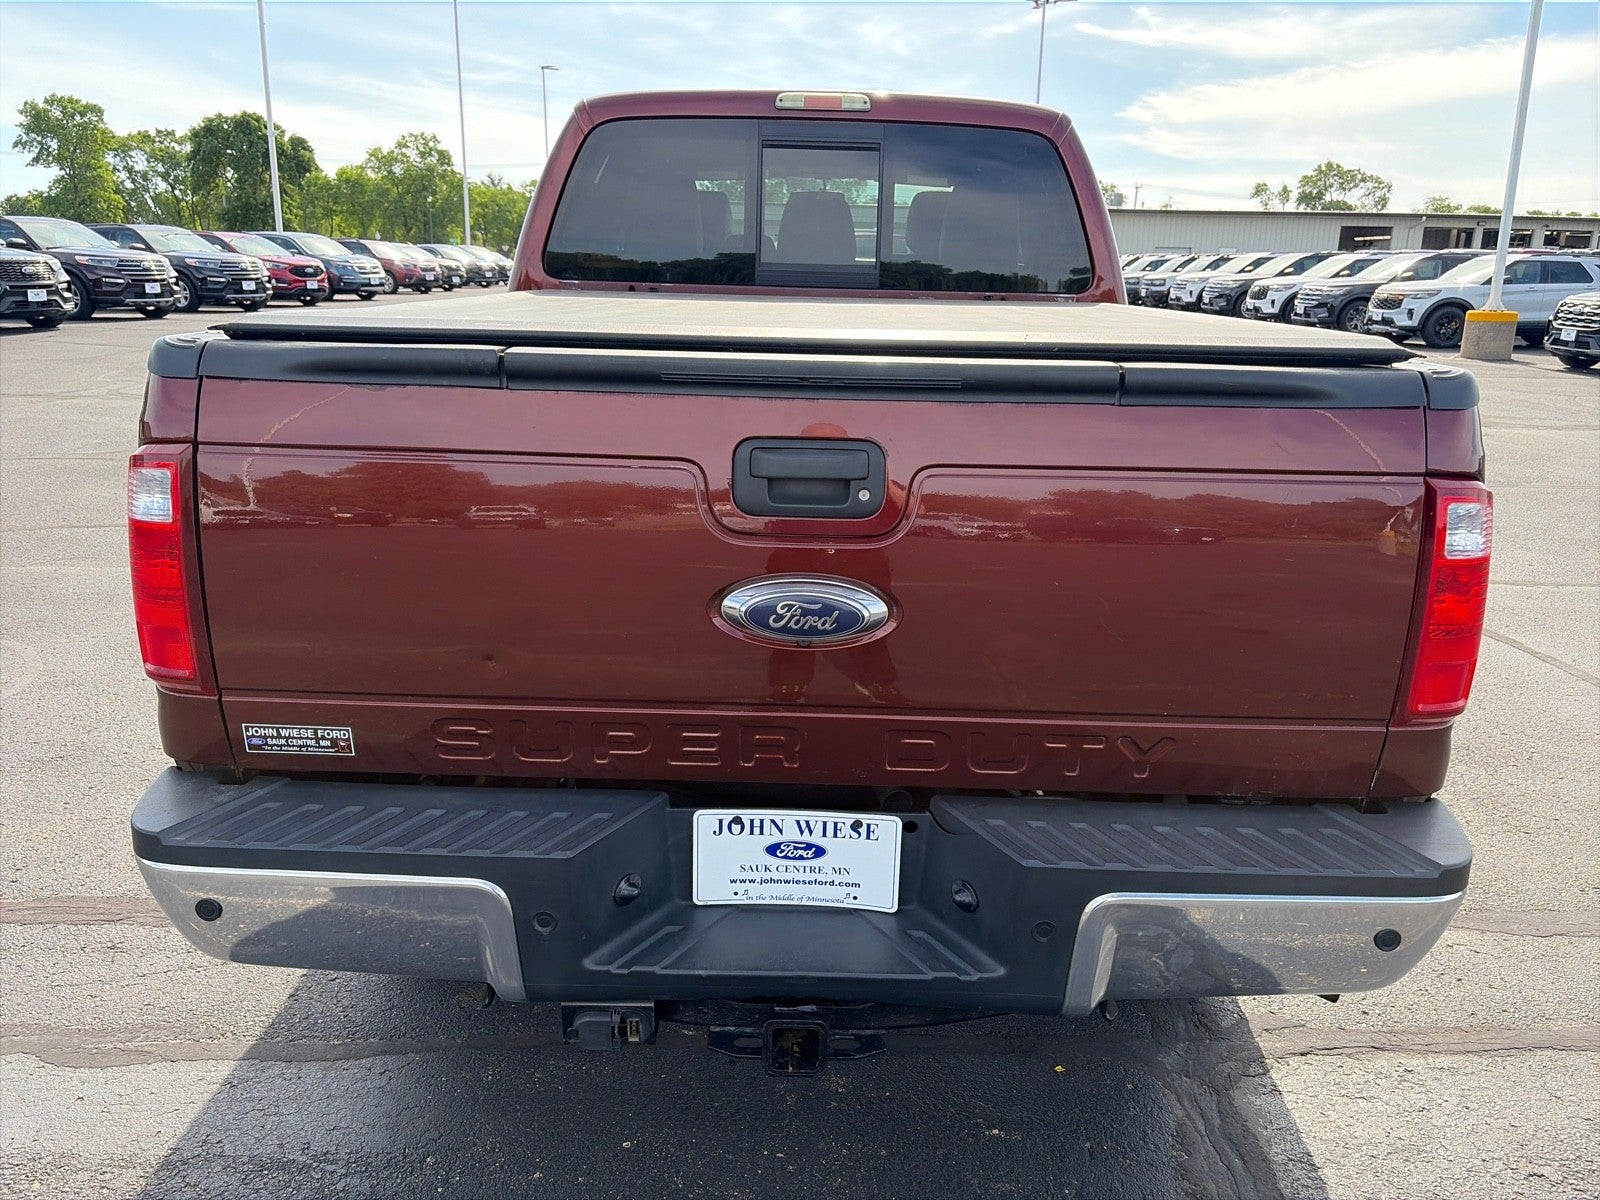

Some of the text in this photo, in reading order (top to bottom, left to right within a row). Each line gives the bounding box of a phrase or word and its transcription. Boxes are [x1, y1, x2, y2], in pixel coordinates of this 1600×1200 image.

[769, 601, 839, 630] Ford
[246, 727, 349, 739] JOHN WIESE FORD
[288, 739, 319, 747] CENTRE,
[430, 717, 1177, 778] SUPER DUTY
[712, 817, 880, 841] JOHN WIESE
[776, 842, 816, 859] Ford
[739, 864, 851, 876] SAUK CENTRE, MN
[729, 877, 861, 889] www.johnwieseford.com
[755, 893, 767, 901] the
[768, 893, 795, 901] Middle
[796, 894, 804, 903] of
[805, 895, 845, 904] Minnesota
